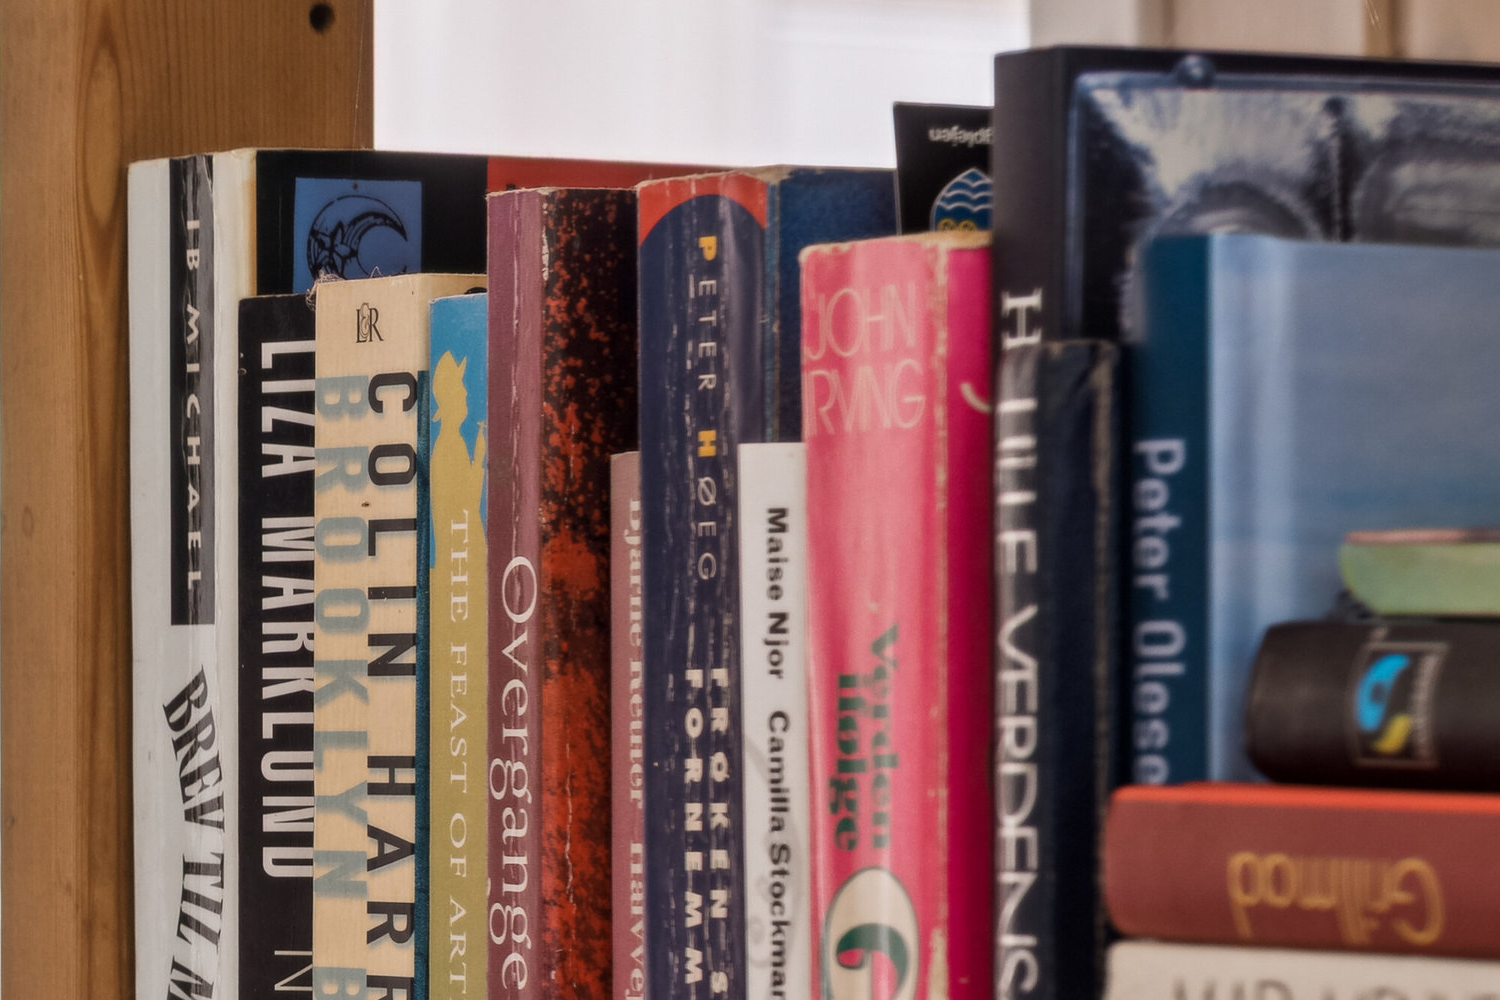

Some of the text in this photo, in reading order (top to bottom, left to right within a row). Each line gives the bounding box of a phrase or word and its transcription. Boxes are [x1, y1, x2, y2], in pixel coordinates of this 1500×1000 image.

[185, 218, 202, 591] IB MICHAEL
[804, 282, 918, 360] JOHN
[804, 358, 926, 435] IRVING
[698, 236, 717, 580] PETER HØEG
[367, 371, 418, 677] COLIN
[450, 509, 470, 622] THE
[763, 507, 790, 679] Maise Njor
[1133, 438, 1185, 600] Peter
[261, 340, 315, 878] LIZA MARKLUND
[314, 374, 371, 898] BROOKLYN
[162, 665, 226, 834] BREV
[450, 645, 470, 794] FEAST
[489, 556, 537, 990] Overgange
[709, 668, 729, 919] FRØKEN
[768, 709, 791, 832] Camilla
[870, 624, 899, 849] Verden
[176, 852, 226, 953] TIL
[449, 812, 469, 878] OF
